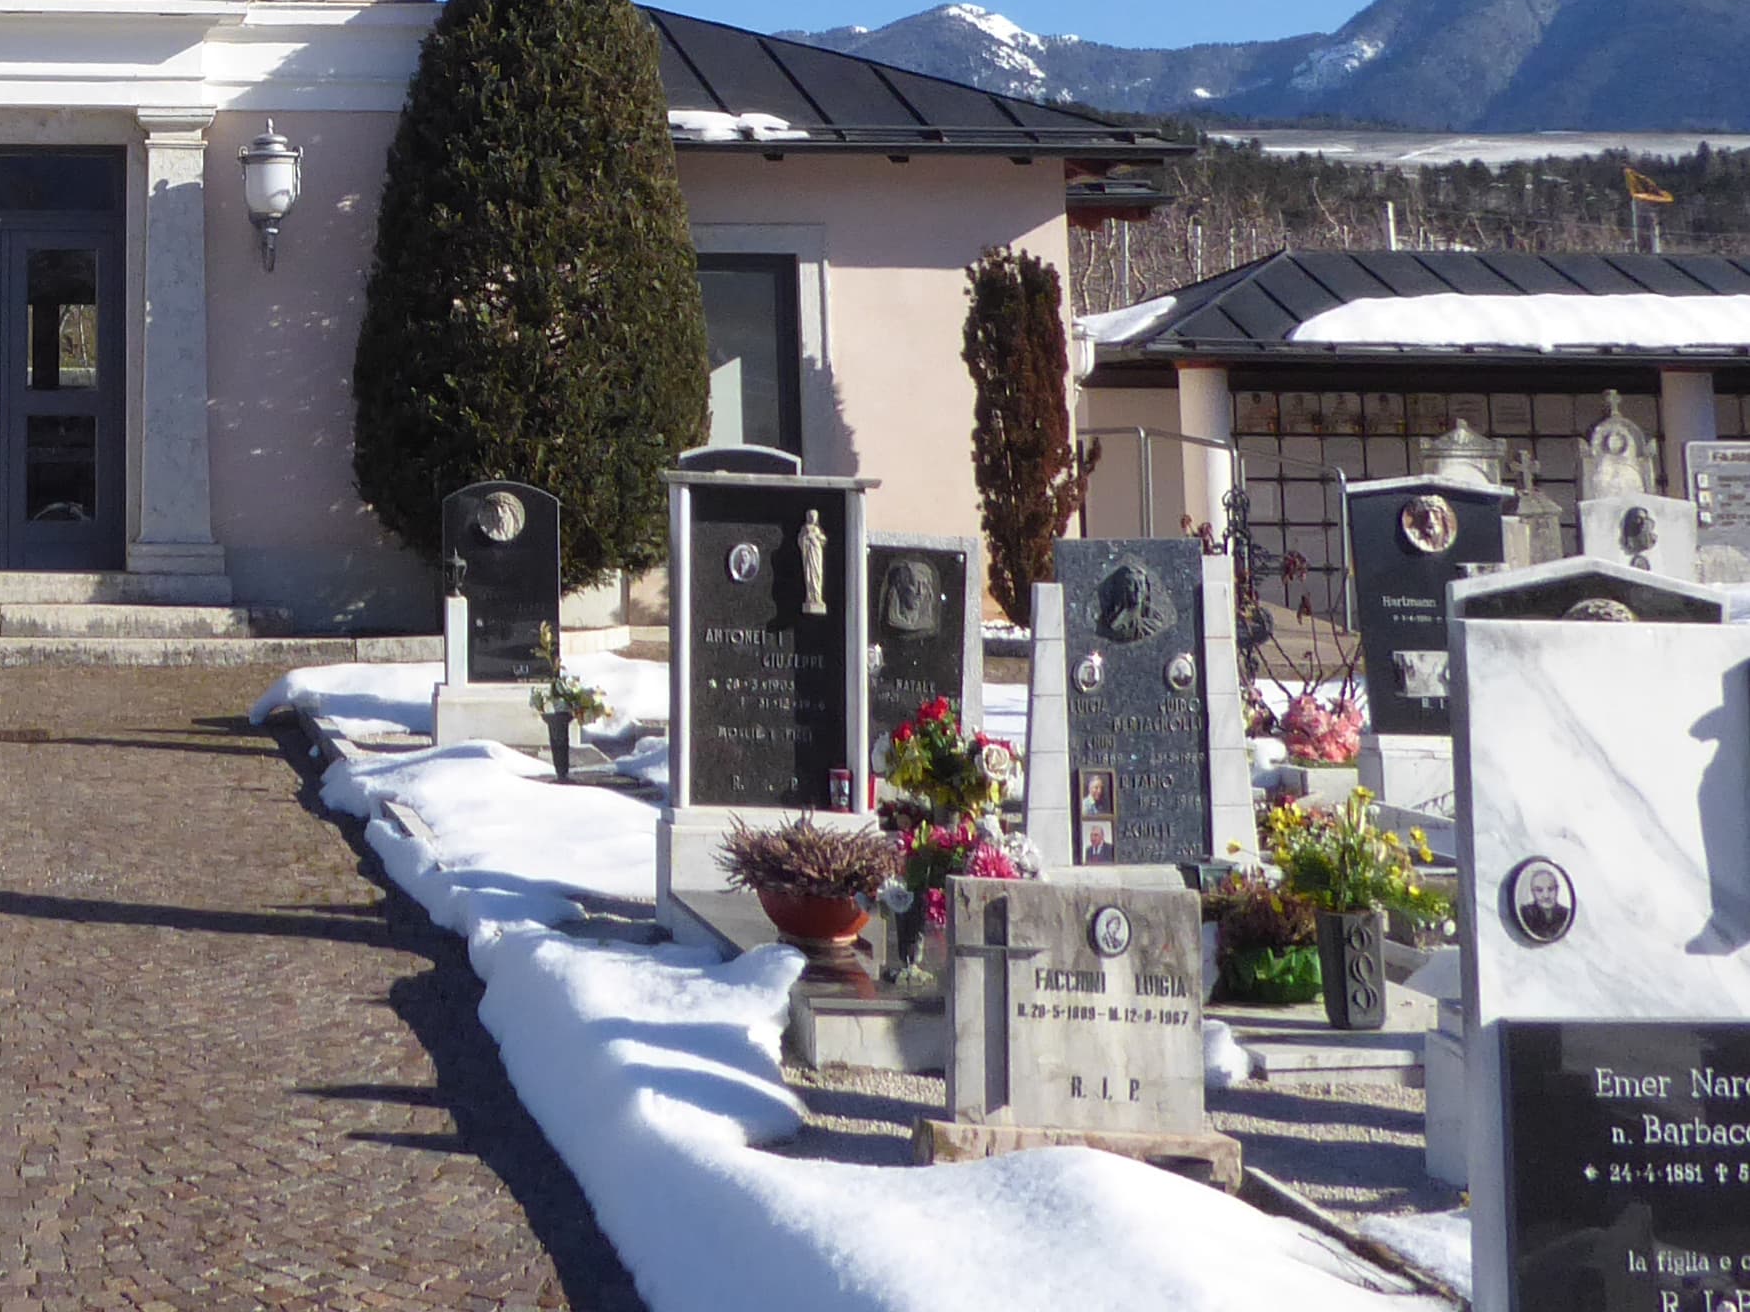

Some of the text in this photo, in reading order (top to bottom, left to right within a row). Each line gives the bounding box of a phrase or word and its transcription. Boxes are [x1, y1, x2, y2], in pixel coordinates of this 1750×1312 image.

[1382, 596, 1437, 608] Hartmann
[1035, 968, 1188, 999] FACCHINI LUIGIA
[1594, 1067, 1672, 1098] Emer
[1611, 1126, 1634, 1145] n.
[1628, 1249, 1648, 1273] la
[1656, 1250, 1710, 1277] figlia
